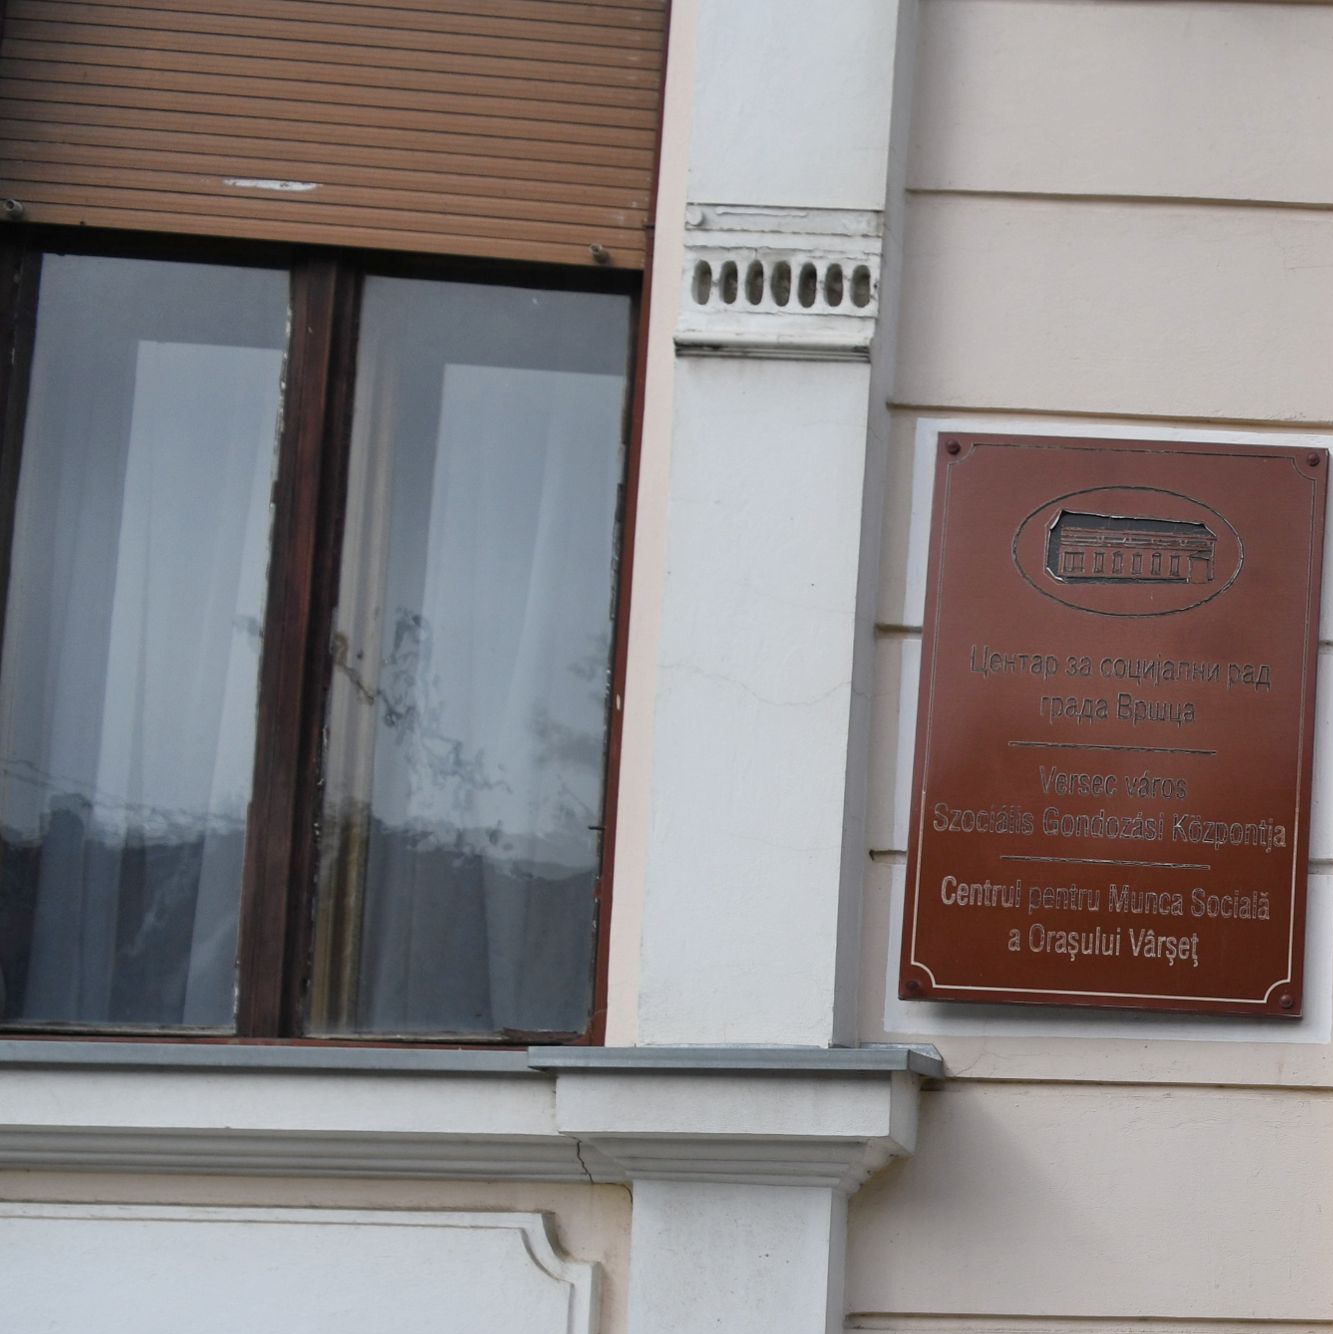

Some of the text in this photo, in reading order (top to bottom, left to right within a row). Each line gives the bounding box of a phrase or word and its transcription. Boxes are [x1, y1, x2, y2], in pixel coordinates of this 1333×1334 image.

[970, 645, 1271, 692] Центар за социјални рад
[1040, 693, 1195, 727] града Вршца
[1040, 766, 1189, 798] Versec város
[933, 803, 1286, 853] Szociális Gondozási Központja
[941, 876, 1270, 920] Centrul pentru Munca Socială
[1008, 929, 1021, 951] a
